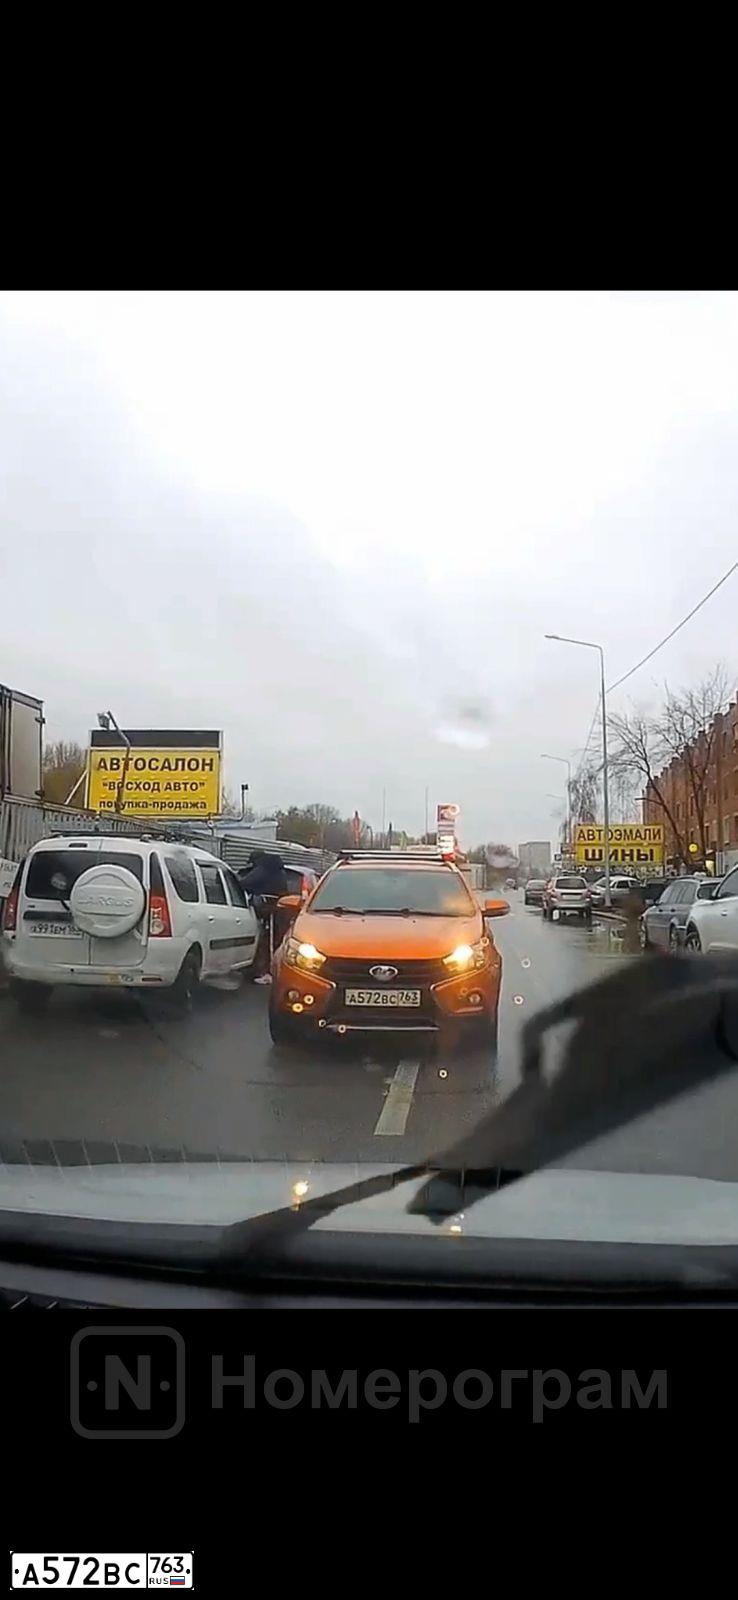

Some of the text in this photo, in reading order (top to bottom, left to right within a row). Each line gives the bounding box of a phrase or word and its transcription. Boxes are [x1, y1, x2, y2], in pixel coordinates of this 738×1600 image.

[97, 757, 214, 772] АВТОСАЛОН
[584, 848, 654, 861] ШИНЫ
[399, 991, 419, 1002] 763
